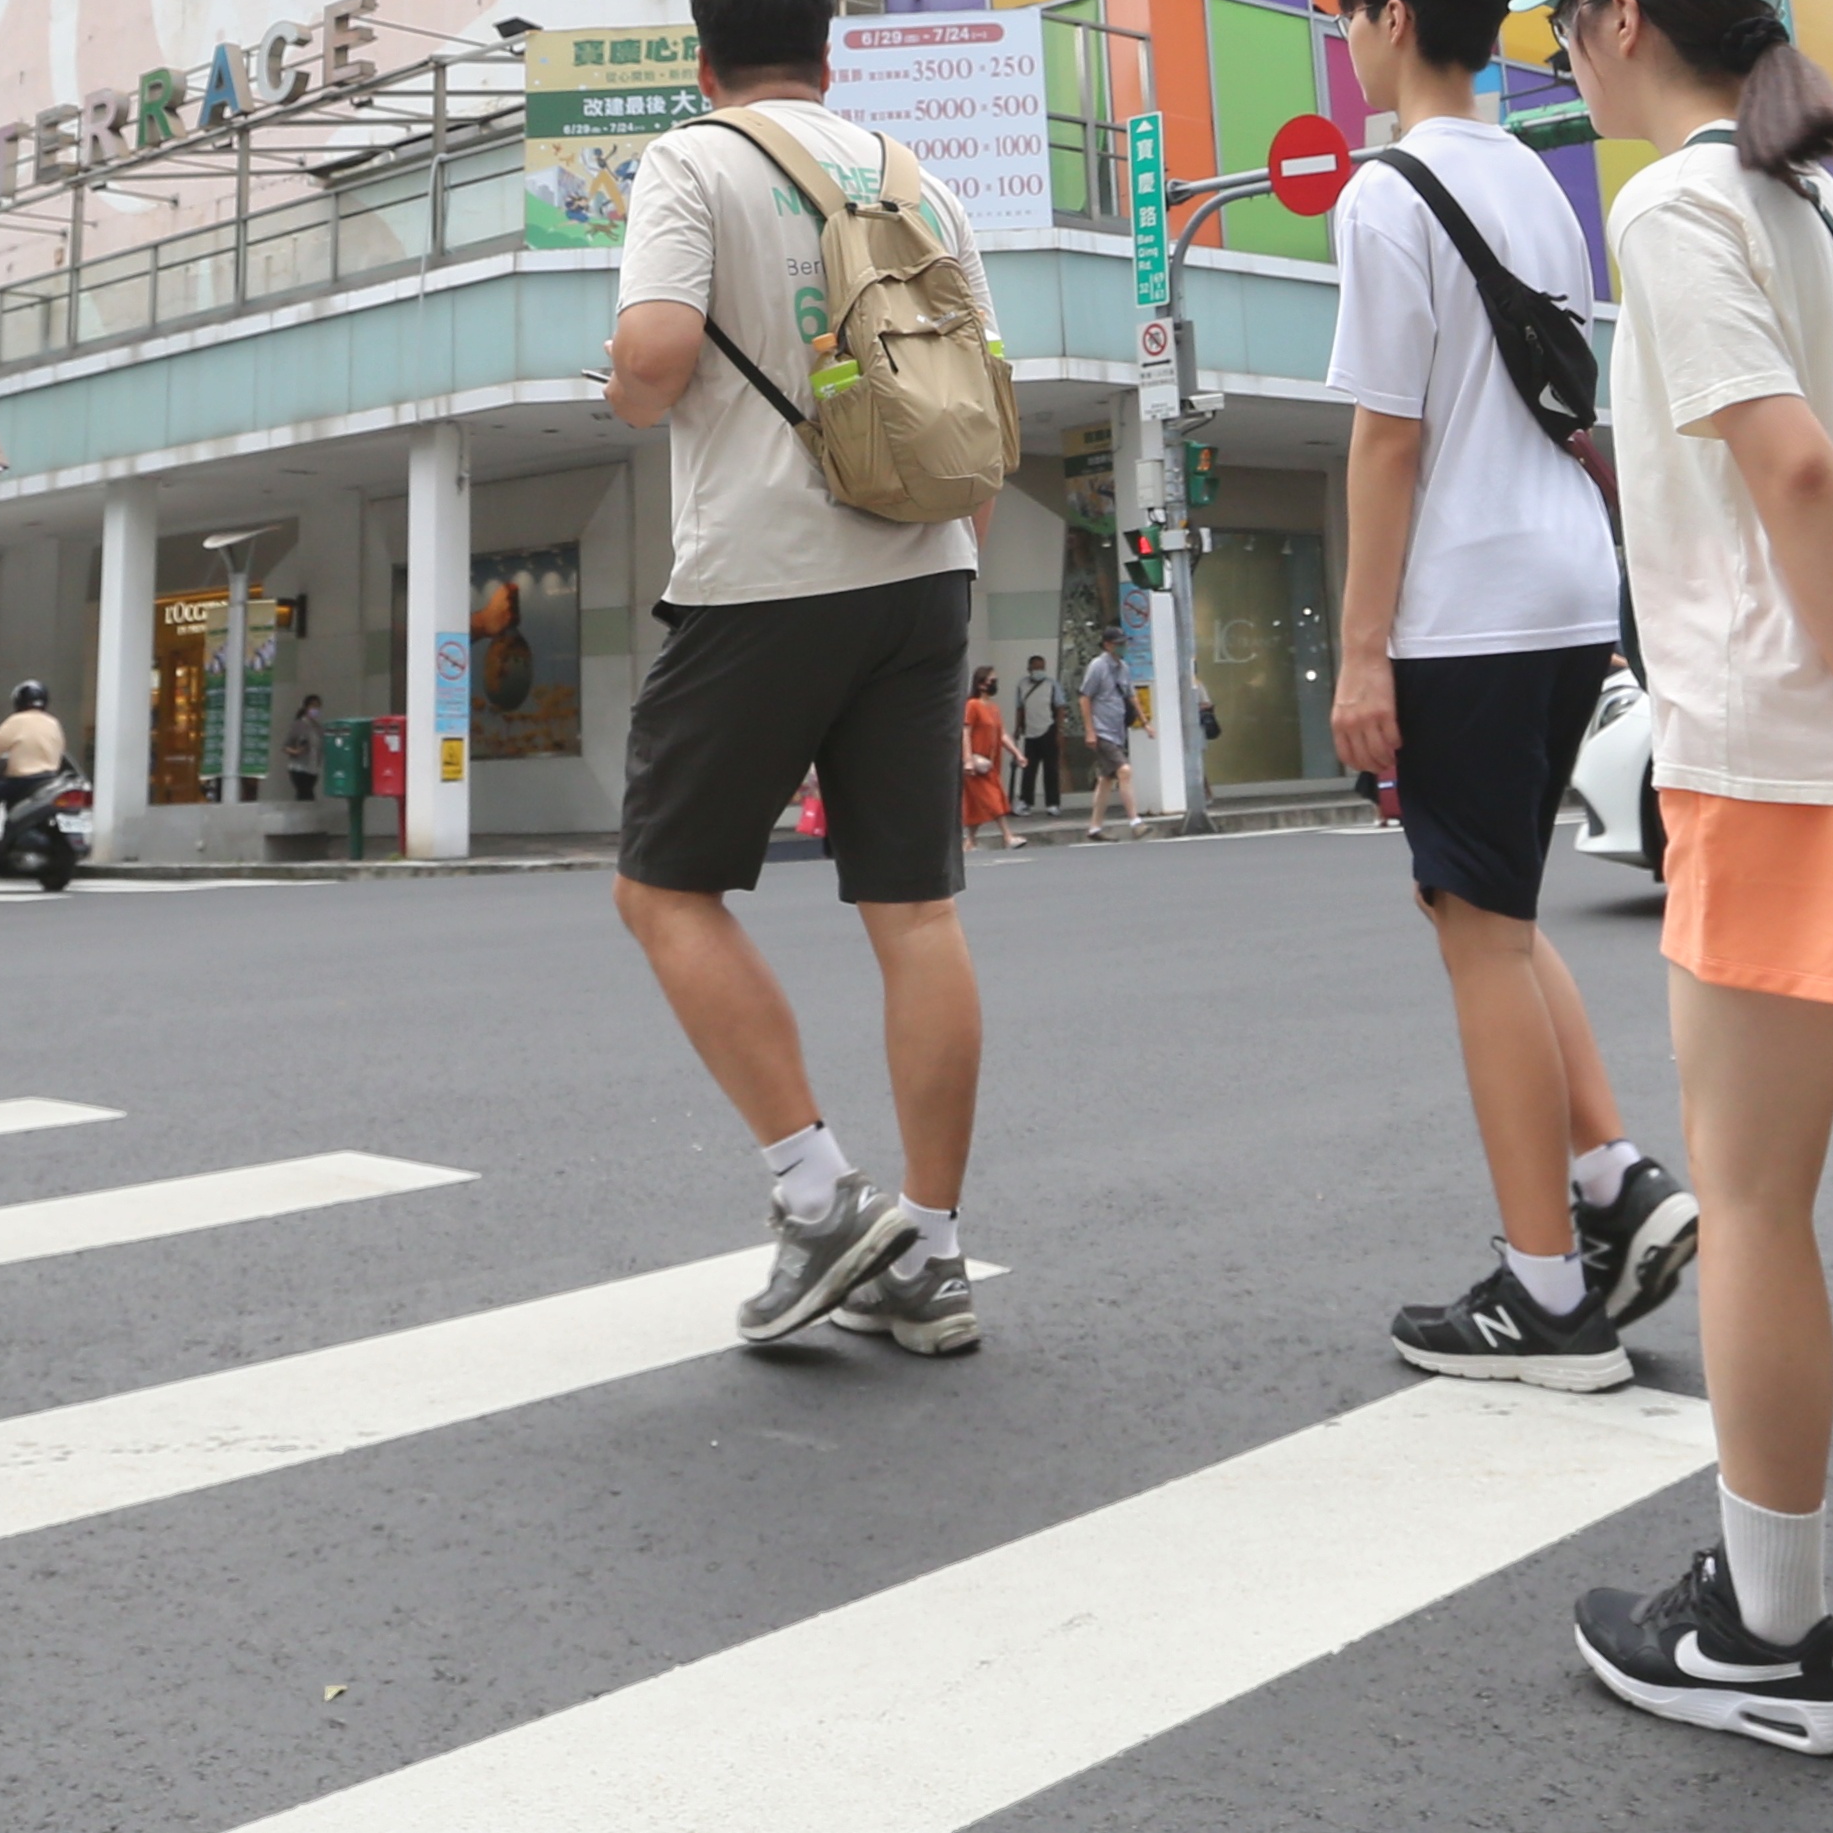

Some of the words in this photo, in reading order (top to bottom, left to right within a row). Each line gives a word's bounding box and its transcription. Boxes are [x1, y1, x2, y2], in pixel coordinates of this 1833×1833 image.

[912, 57, 973, 82] 3500
[990, 54, 1036, 78] 250
[914, 97, 977, 122] 5000
[992, 93, 1039, 118] 500
[995, 134, 1042, 158] 1000
[998, 174, 1044, 197] 100
[1136, 139, 1157, 228] 寶慶路
[1138, 234, 1155, 246] Bao
[1138, 246, 1159, 258] Qing
[1471, 1304, 1524, 1349] N
